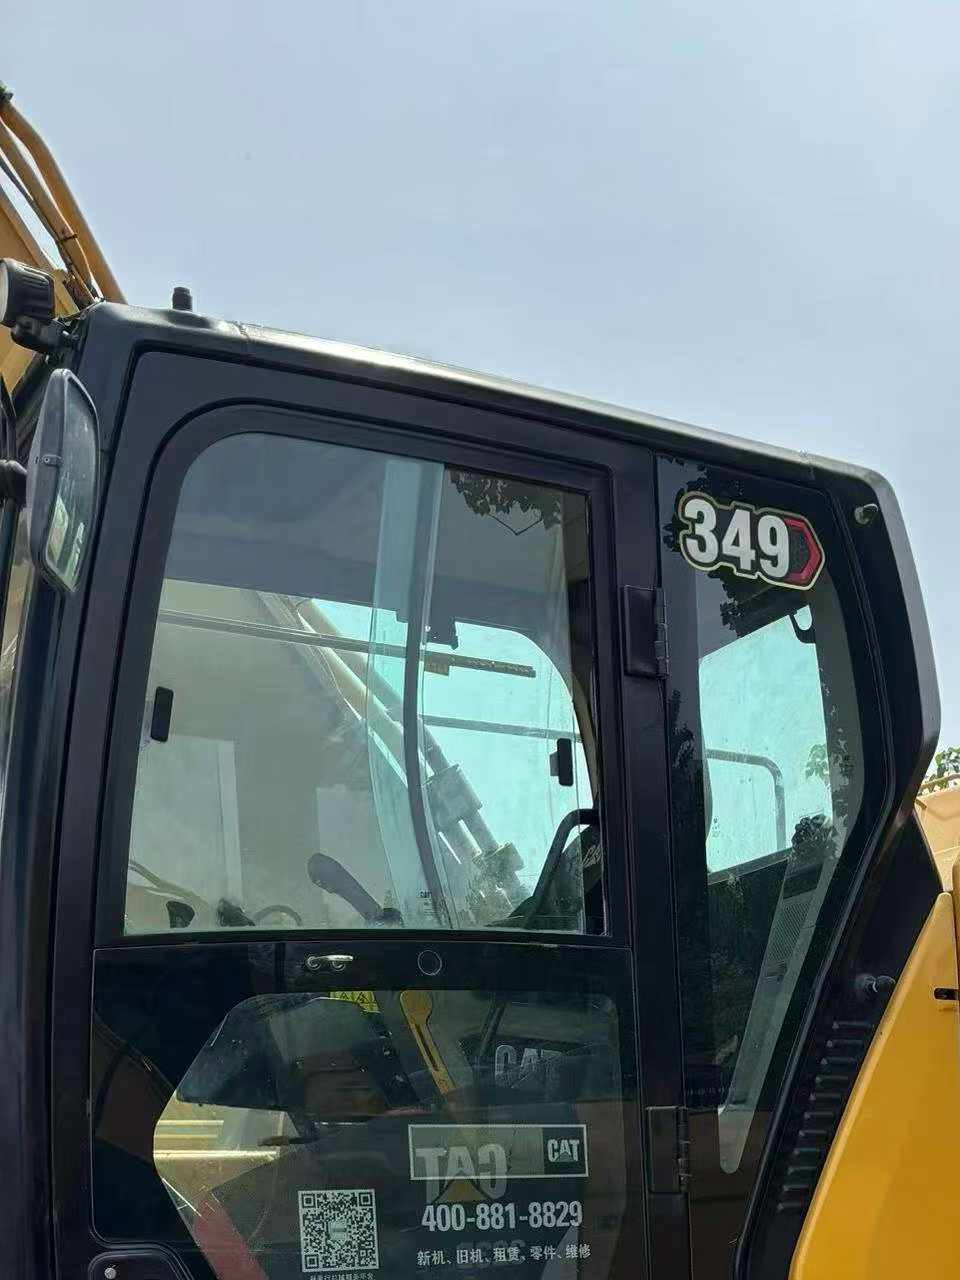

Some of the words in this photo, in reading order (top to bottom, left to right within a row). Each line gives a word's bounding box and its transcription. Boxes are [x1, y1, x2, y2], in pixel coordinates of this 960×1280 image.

[684, 498, 789, 578] 349
[547, 1138, 580, 1162] CAT
[421, 1200, 583, 1232] 400-881-8829
